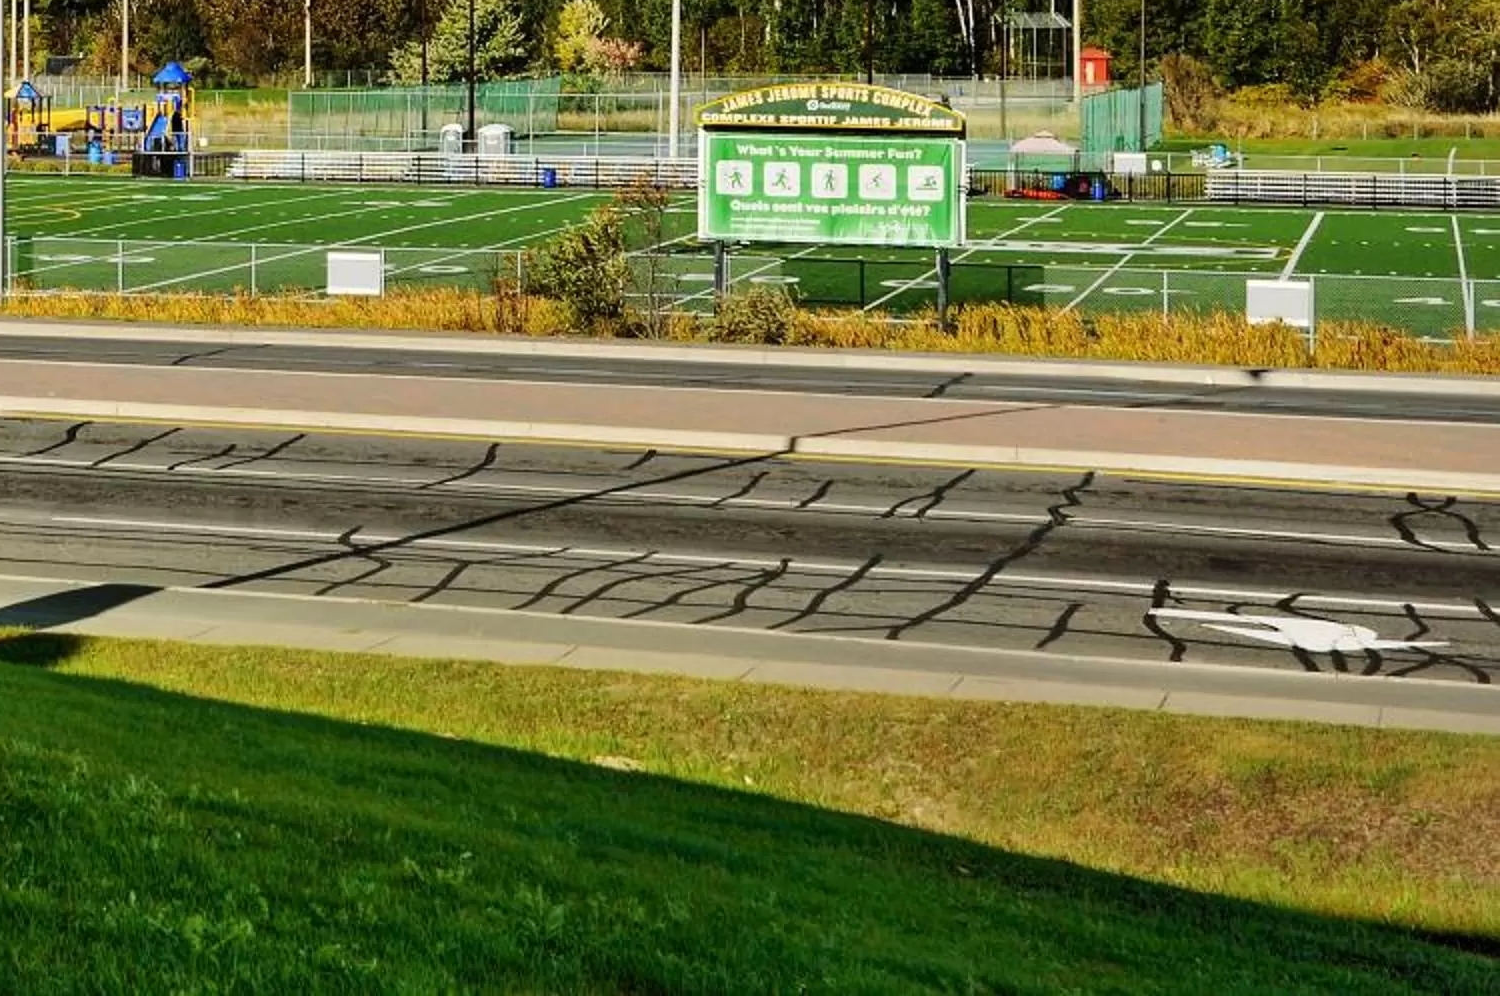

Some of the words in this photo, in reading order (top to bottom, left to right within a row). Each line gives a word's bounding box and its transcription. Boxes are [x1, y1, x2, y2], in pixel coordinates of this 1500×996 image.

[722, 90, 763, 113] JAMES
[821, 86, 870, 103] SPORTS
[872, 91, 932, 117] COMPLEX
[701, 112, 776, 123] COMPLEXE
[780, 115, 837, 125] SPORTIF
[841, 116, 891, 126] JAMES
[788, 145, 823, 157] Your
[824, 147, 886, 159] Summer
[887, 148, 923, 160] Fun?
[730, 200, 771, 211] Quels
[772, 202, 802, 213] sont
